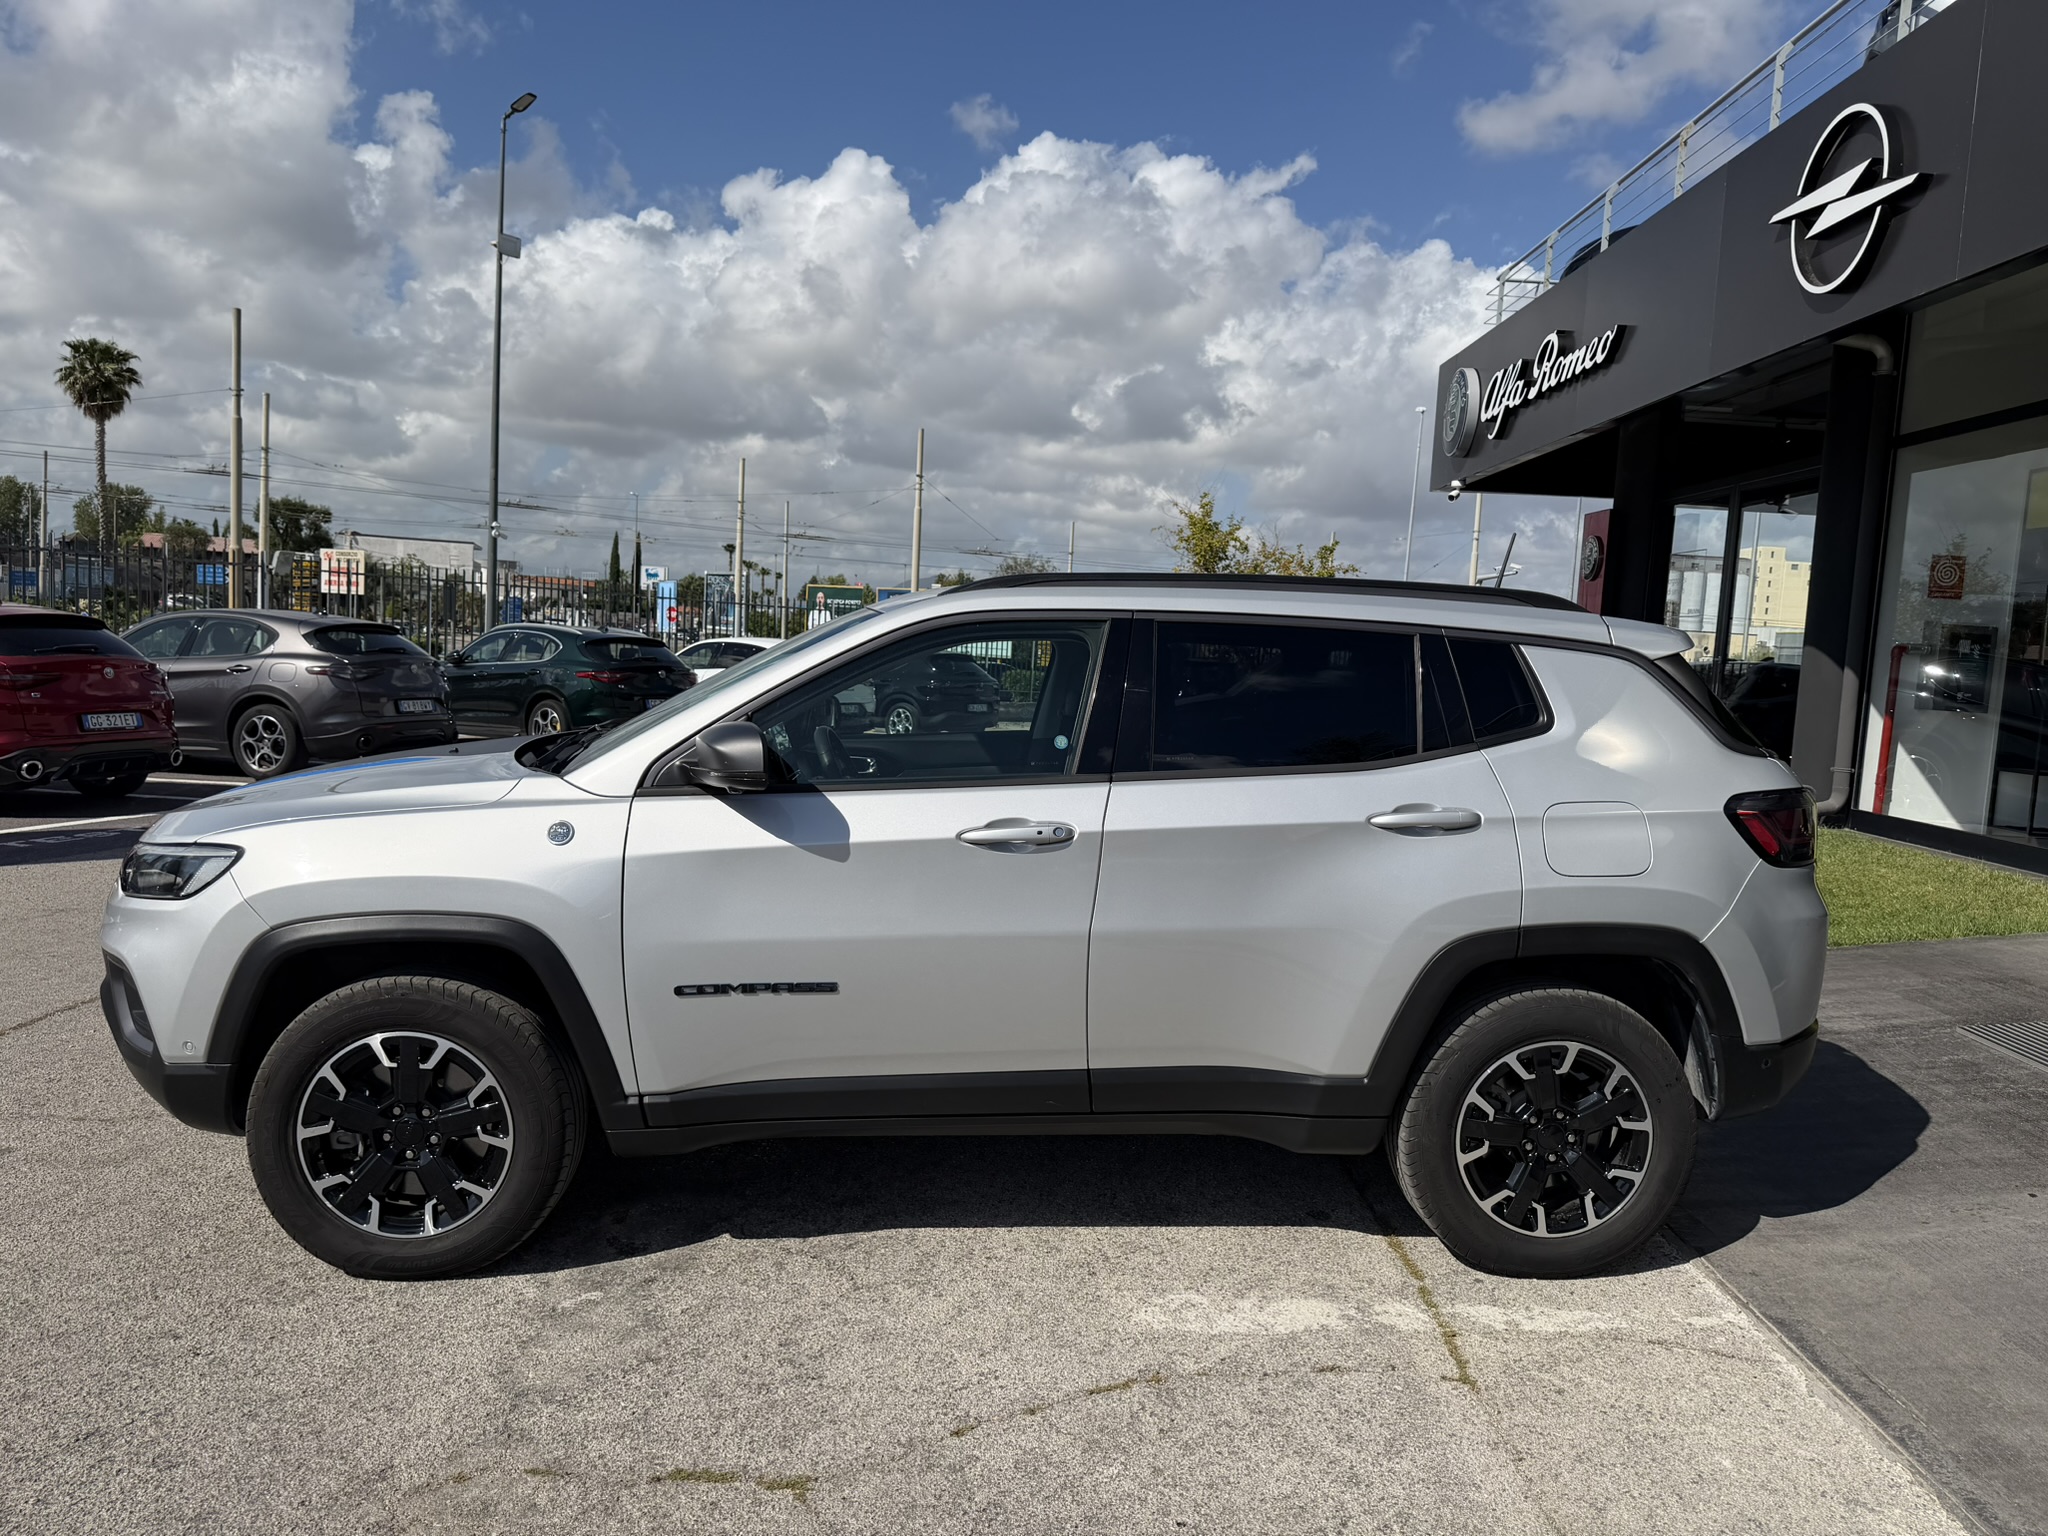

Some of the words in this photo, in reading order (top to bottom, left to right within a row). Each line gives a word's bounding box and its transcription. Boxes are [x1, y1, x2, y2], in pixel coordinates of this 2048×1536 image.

[1481, 358, 1527, 440] Alfa
[1527, 324, 1618, 400] Romeo
[105, 713, 136, 727] 321ET
[674, 982, 839, 997] COMPASS
